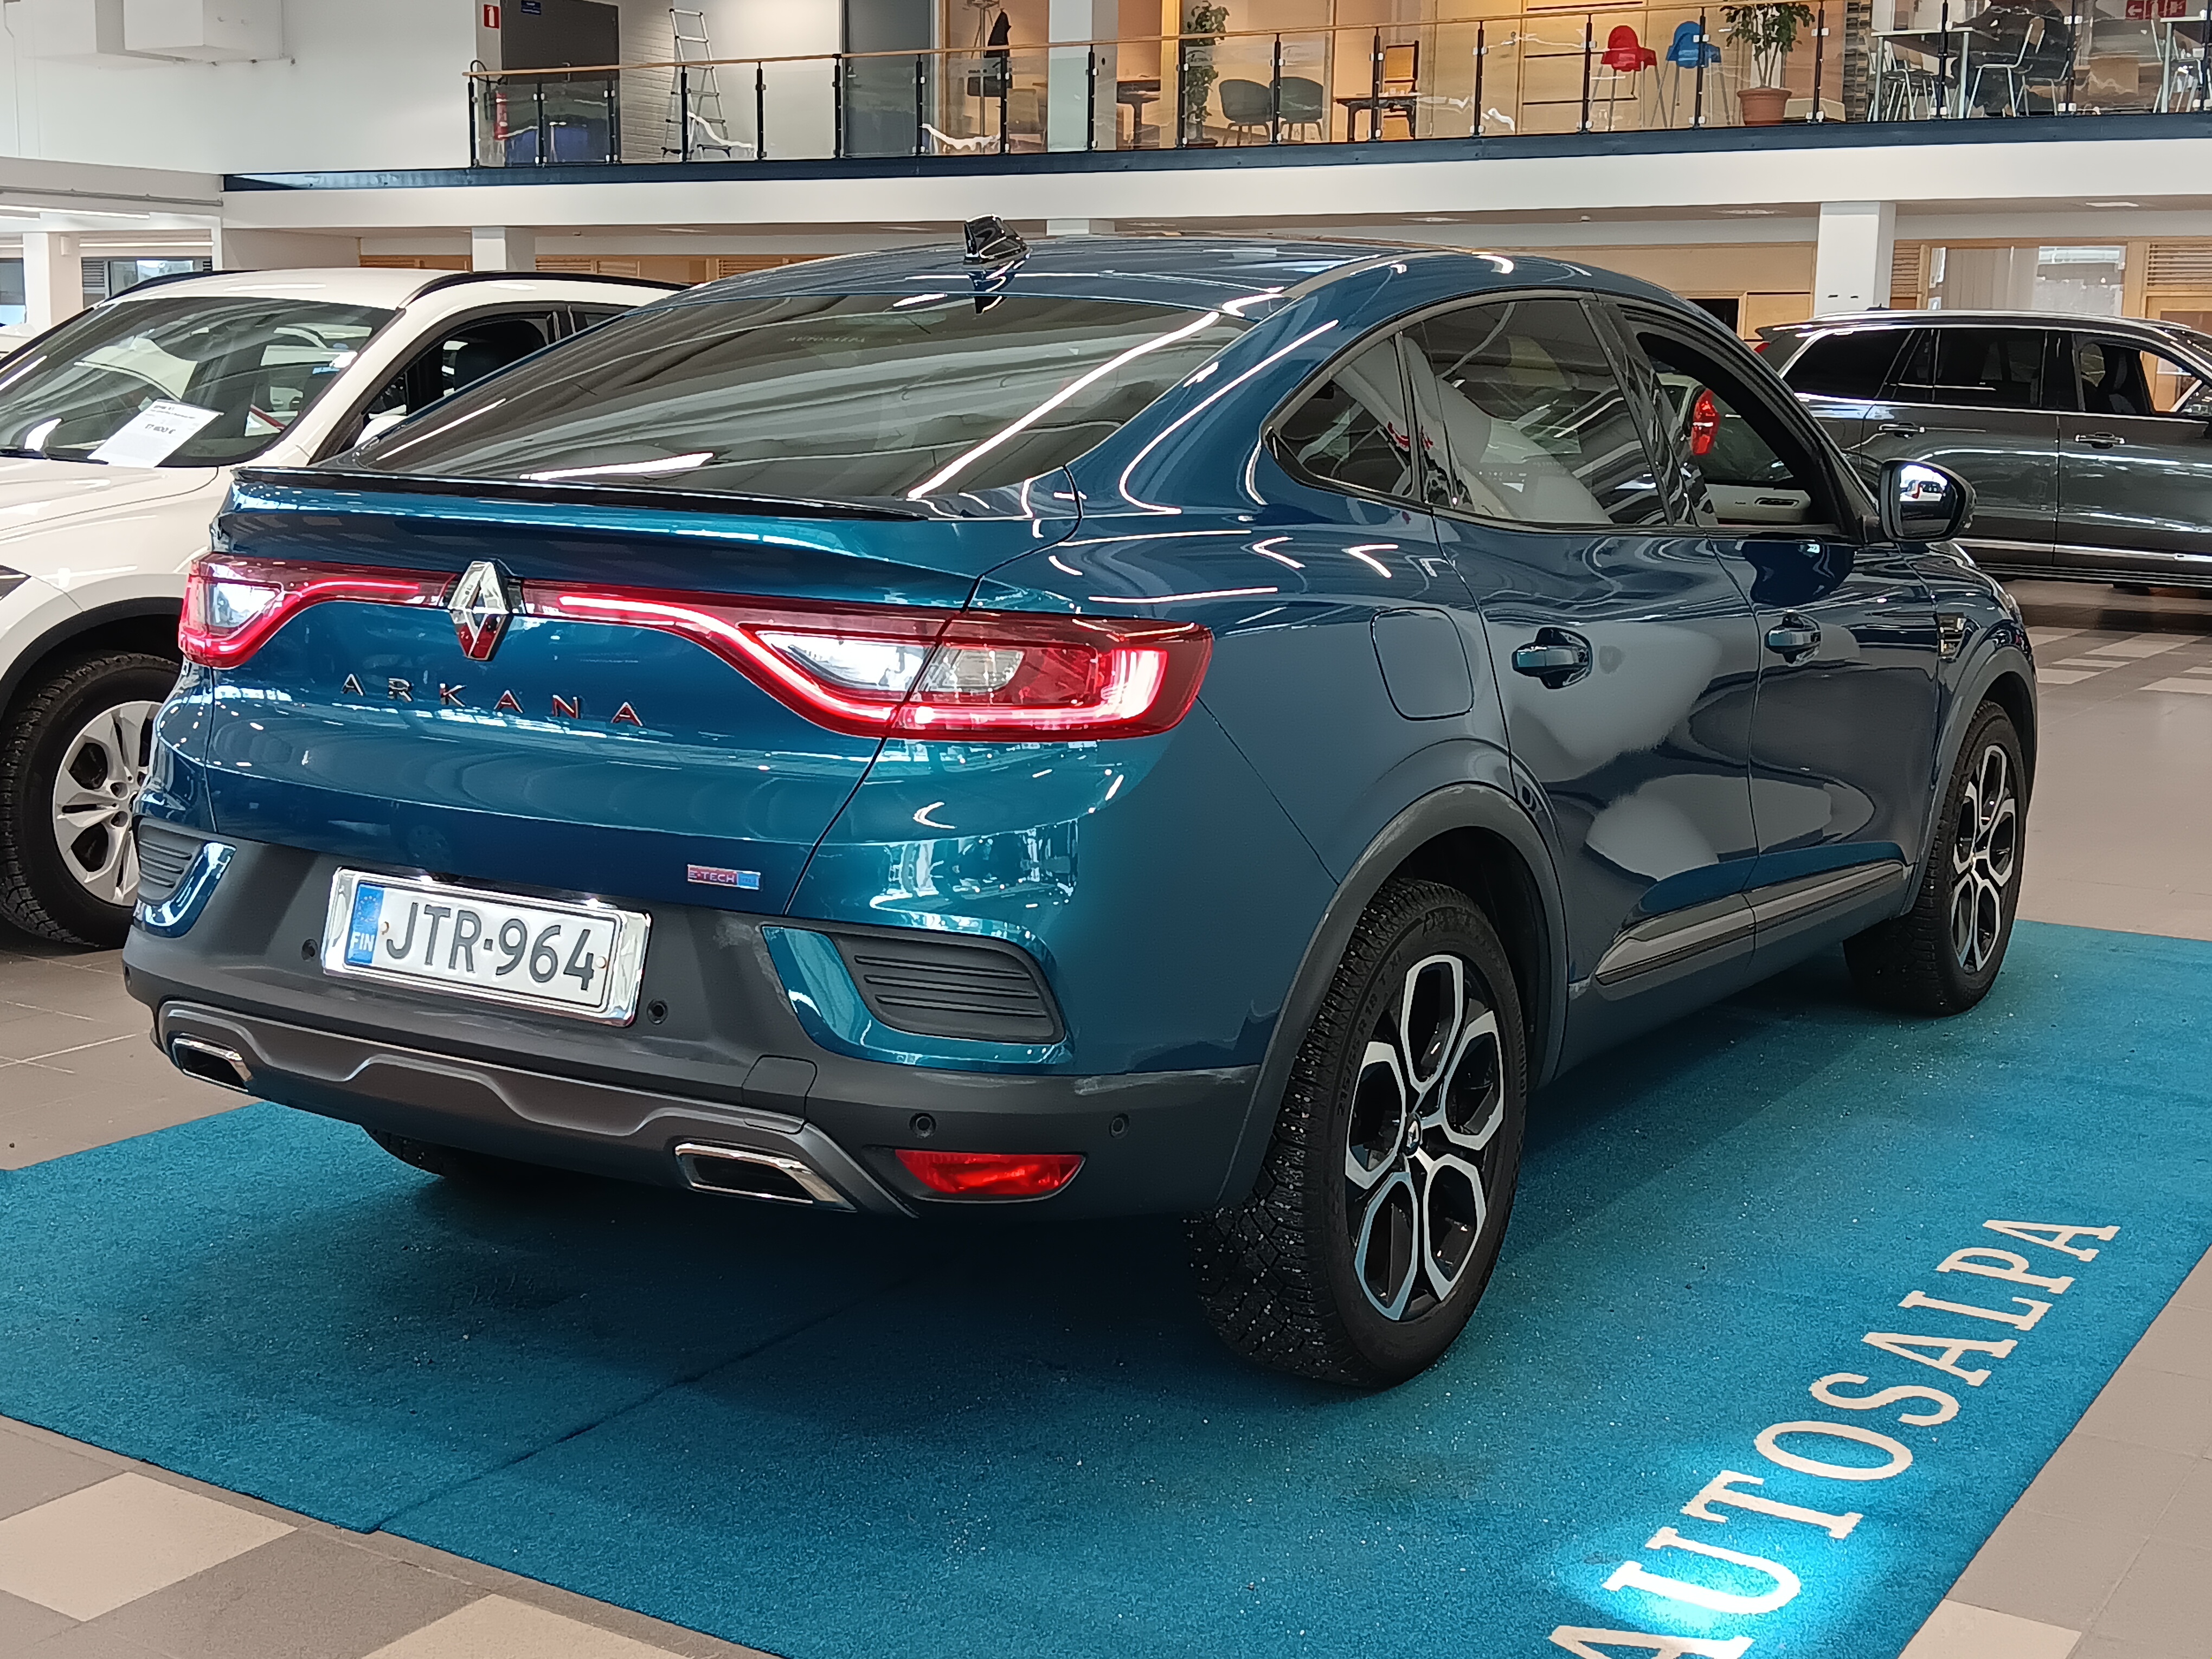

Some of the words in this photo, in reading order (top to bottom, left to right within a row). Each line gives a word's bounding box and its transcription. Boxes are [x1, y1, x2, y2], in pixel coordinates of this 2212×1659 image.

[341, 673, 643, 726] ARKANA
[350, 932, 375, 951] FIN
[386, 902, 595, 991] JTR-964
